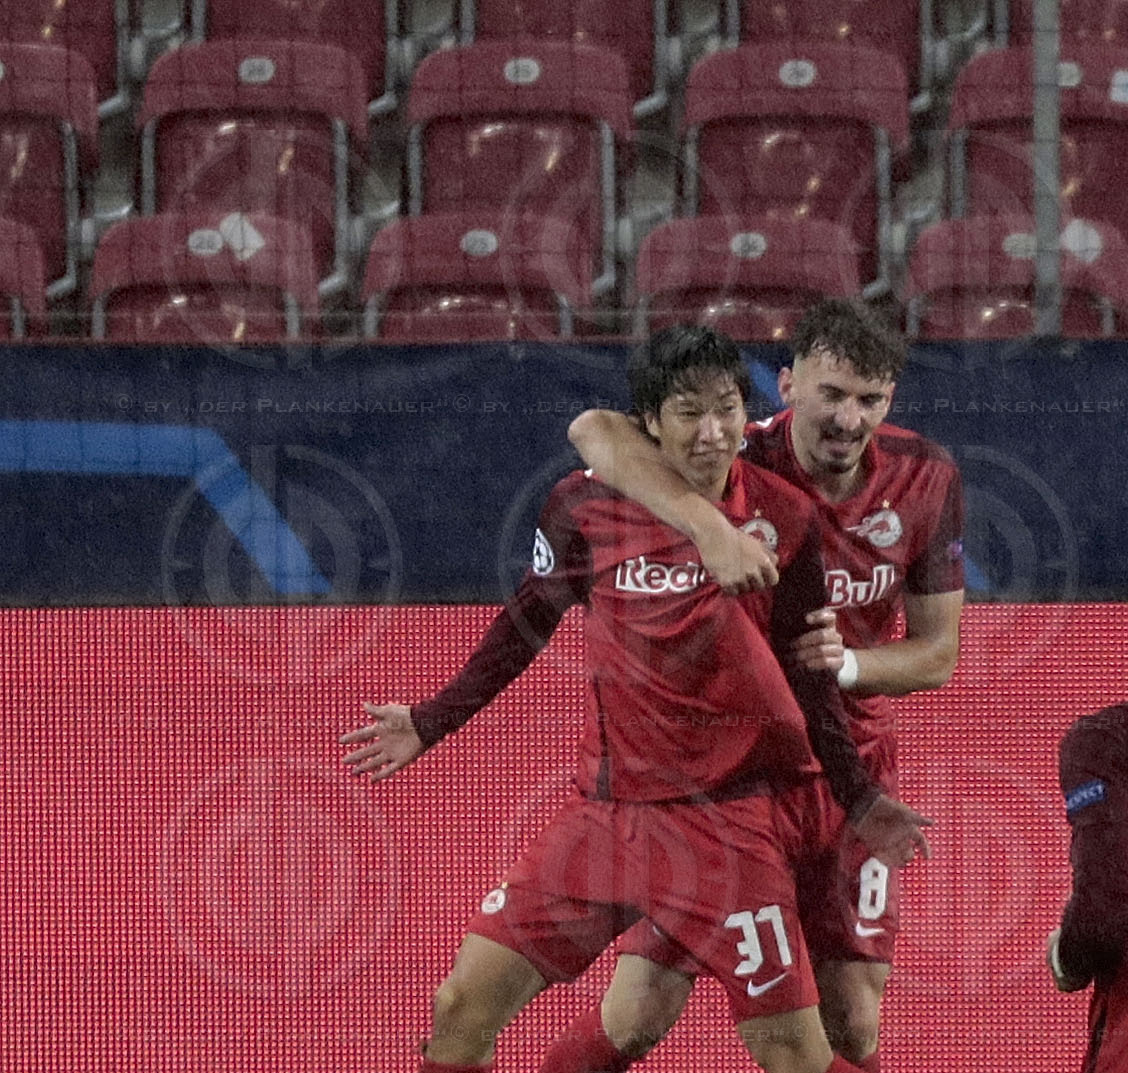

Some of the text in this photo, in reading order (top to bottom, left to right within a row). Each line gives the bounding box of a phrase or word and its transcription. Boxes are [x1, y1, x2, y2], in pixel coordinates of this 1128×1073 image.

[825, 564, 895, 609] Bull
[858, 857, 889, 920] 8
[724, 905, 793, 976] 31
